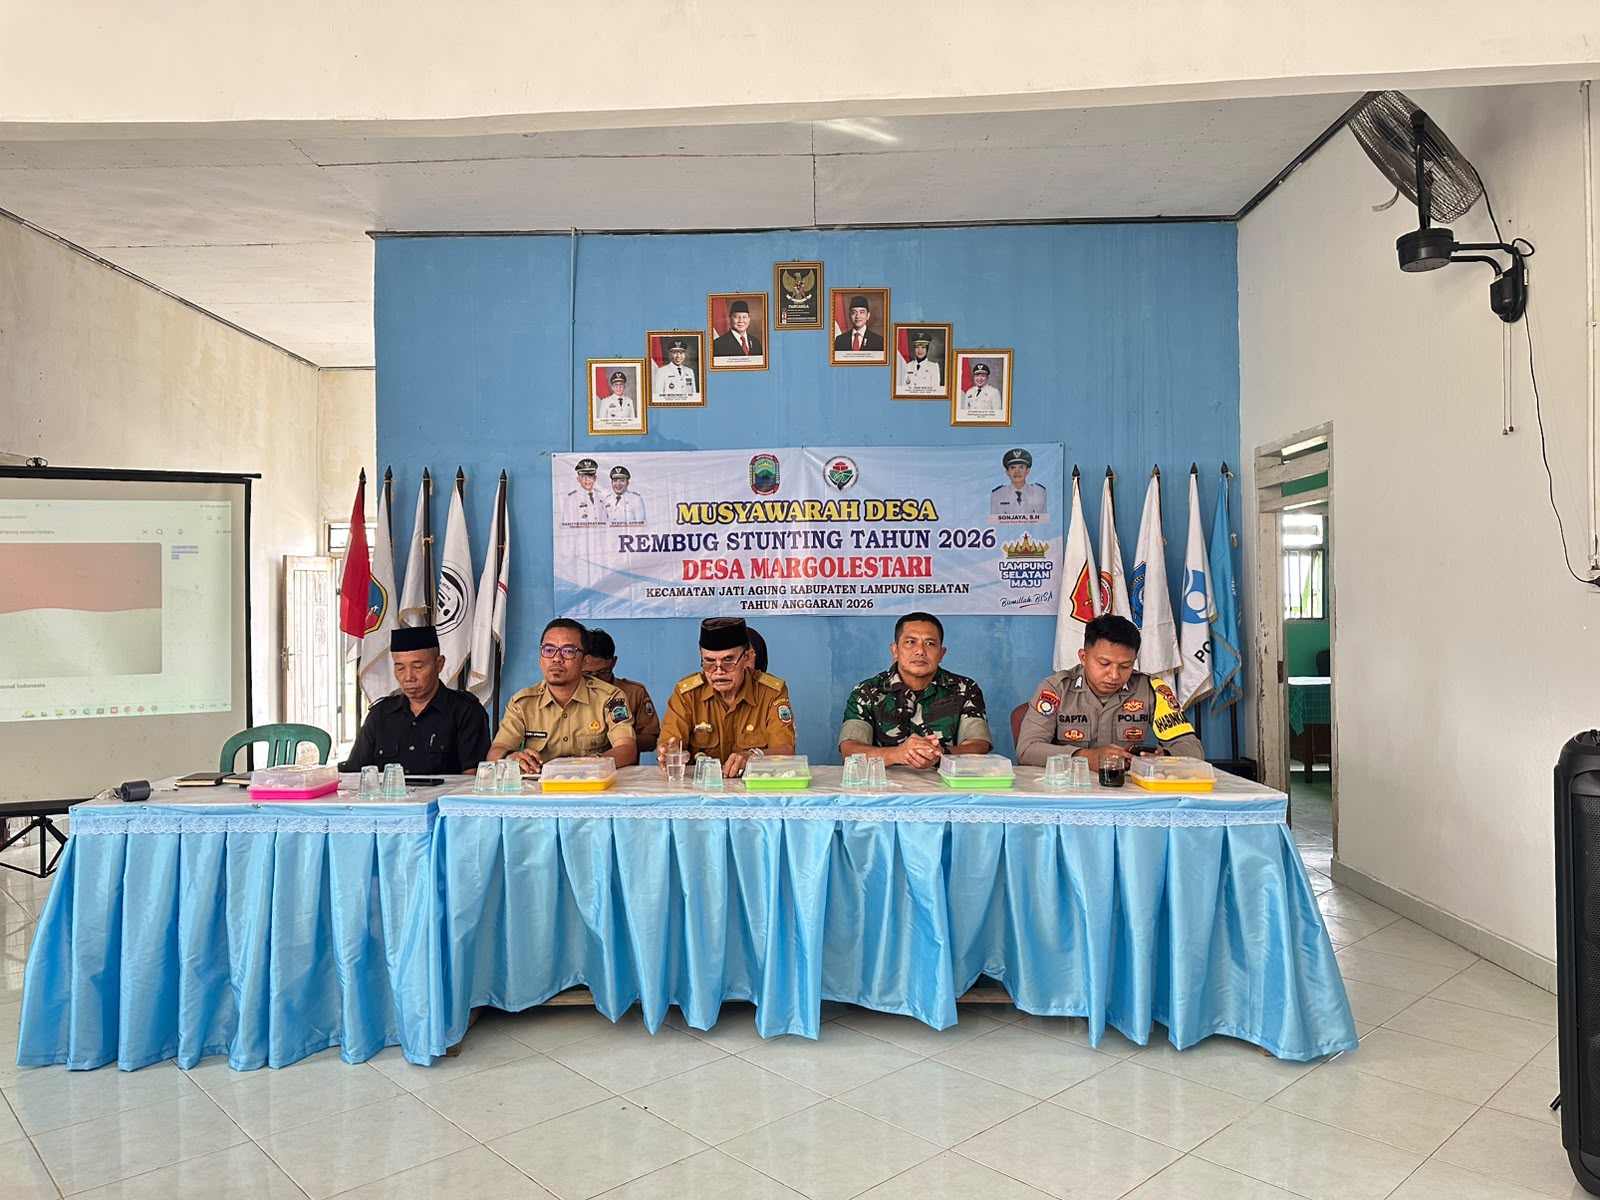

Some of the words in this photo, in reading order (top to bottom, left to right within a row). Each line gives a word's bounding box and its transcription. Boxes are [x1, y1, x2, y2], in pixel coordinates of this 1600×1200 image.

[676, 499, 861, 525] MUSYAWARAH
[864, 499, 939, 522] DESA
[618, 533, 720, 553] REMBUG
[726, 530, 843, 551] STUNTING
[850, 530, 931, 549] TAHUN
[938, 529, 996, 548] 2026
[682, 558, 745, 580] DESA
[751, 556, 932, 580] MARGOLESTARI
[999, 561, 1053, 571] LAMPUNG
[1002, 570, 1050, 579] SELATAN
[1010, 579, 1042, 588] MAJU
[646, 586, 715, 598] KECAMATAN
[719, 586, 744, 596] JATI
[747, 585, 787, 596] AGUNG
[790, 584, 857, 595] KABUPATEN
[860, 584, 915, 594] LAMPUNG
[918, 583, 969, 594] SELATAN
[1034, 591, 1053, 603] BISA
[740, 600, 778, 609] TAHUN
[782, 599, 843, 609] ANGGARAN
[846, 598, 874, 609] 2026
[1058, 714, 1088, 723] SAPTA
[1118, 714, 1149, 723] POLRI
